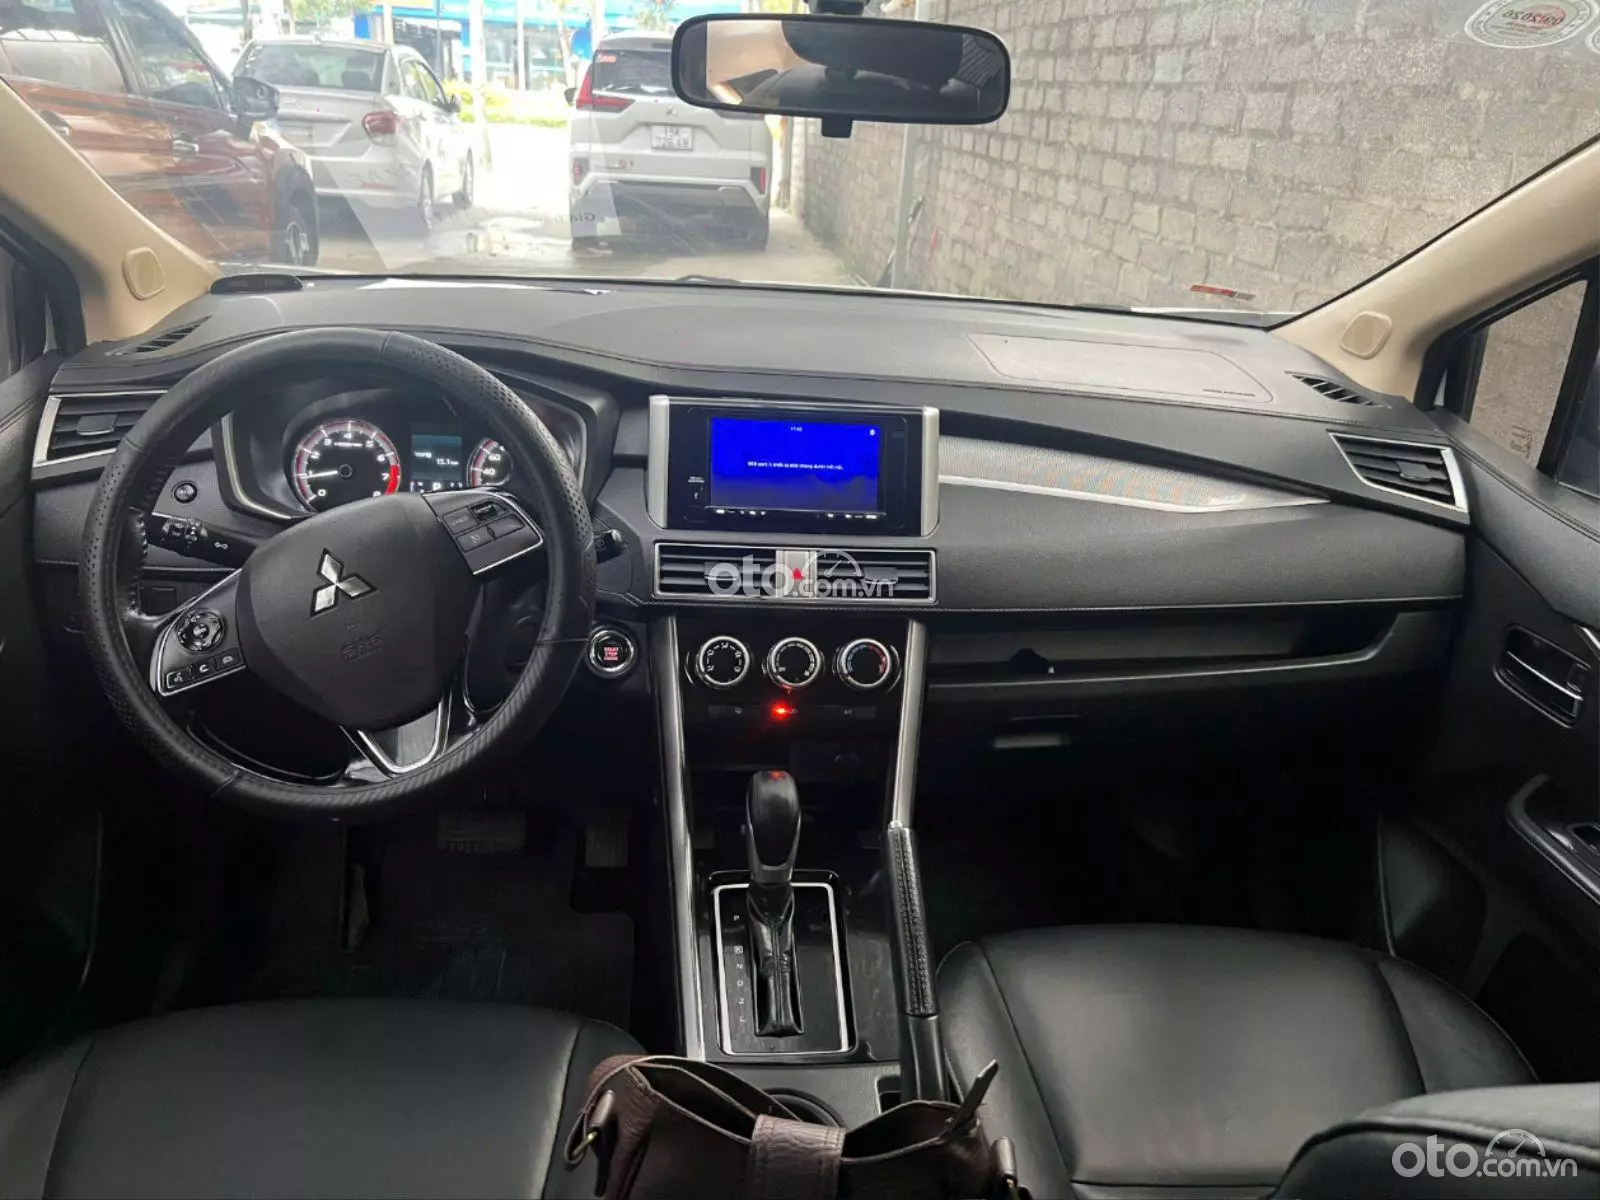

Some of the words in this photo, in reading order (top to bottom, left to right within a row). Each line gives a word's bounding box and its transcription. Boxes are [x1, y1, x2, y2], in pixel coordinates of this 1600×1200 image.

[323, 438, 332, 446] 3
[488, 454, 502, 462] 60
[483, 467, 496, 475] 40
[317, 488, 327, 497] 0
